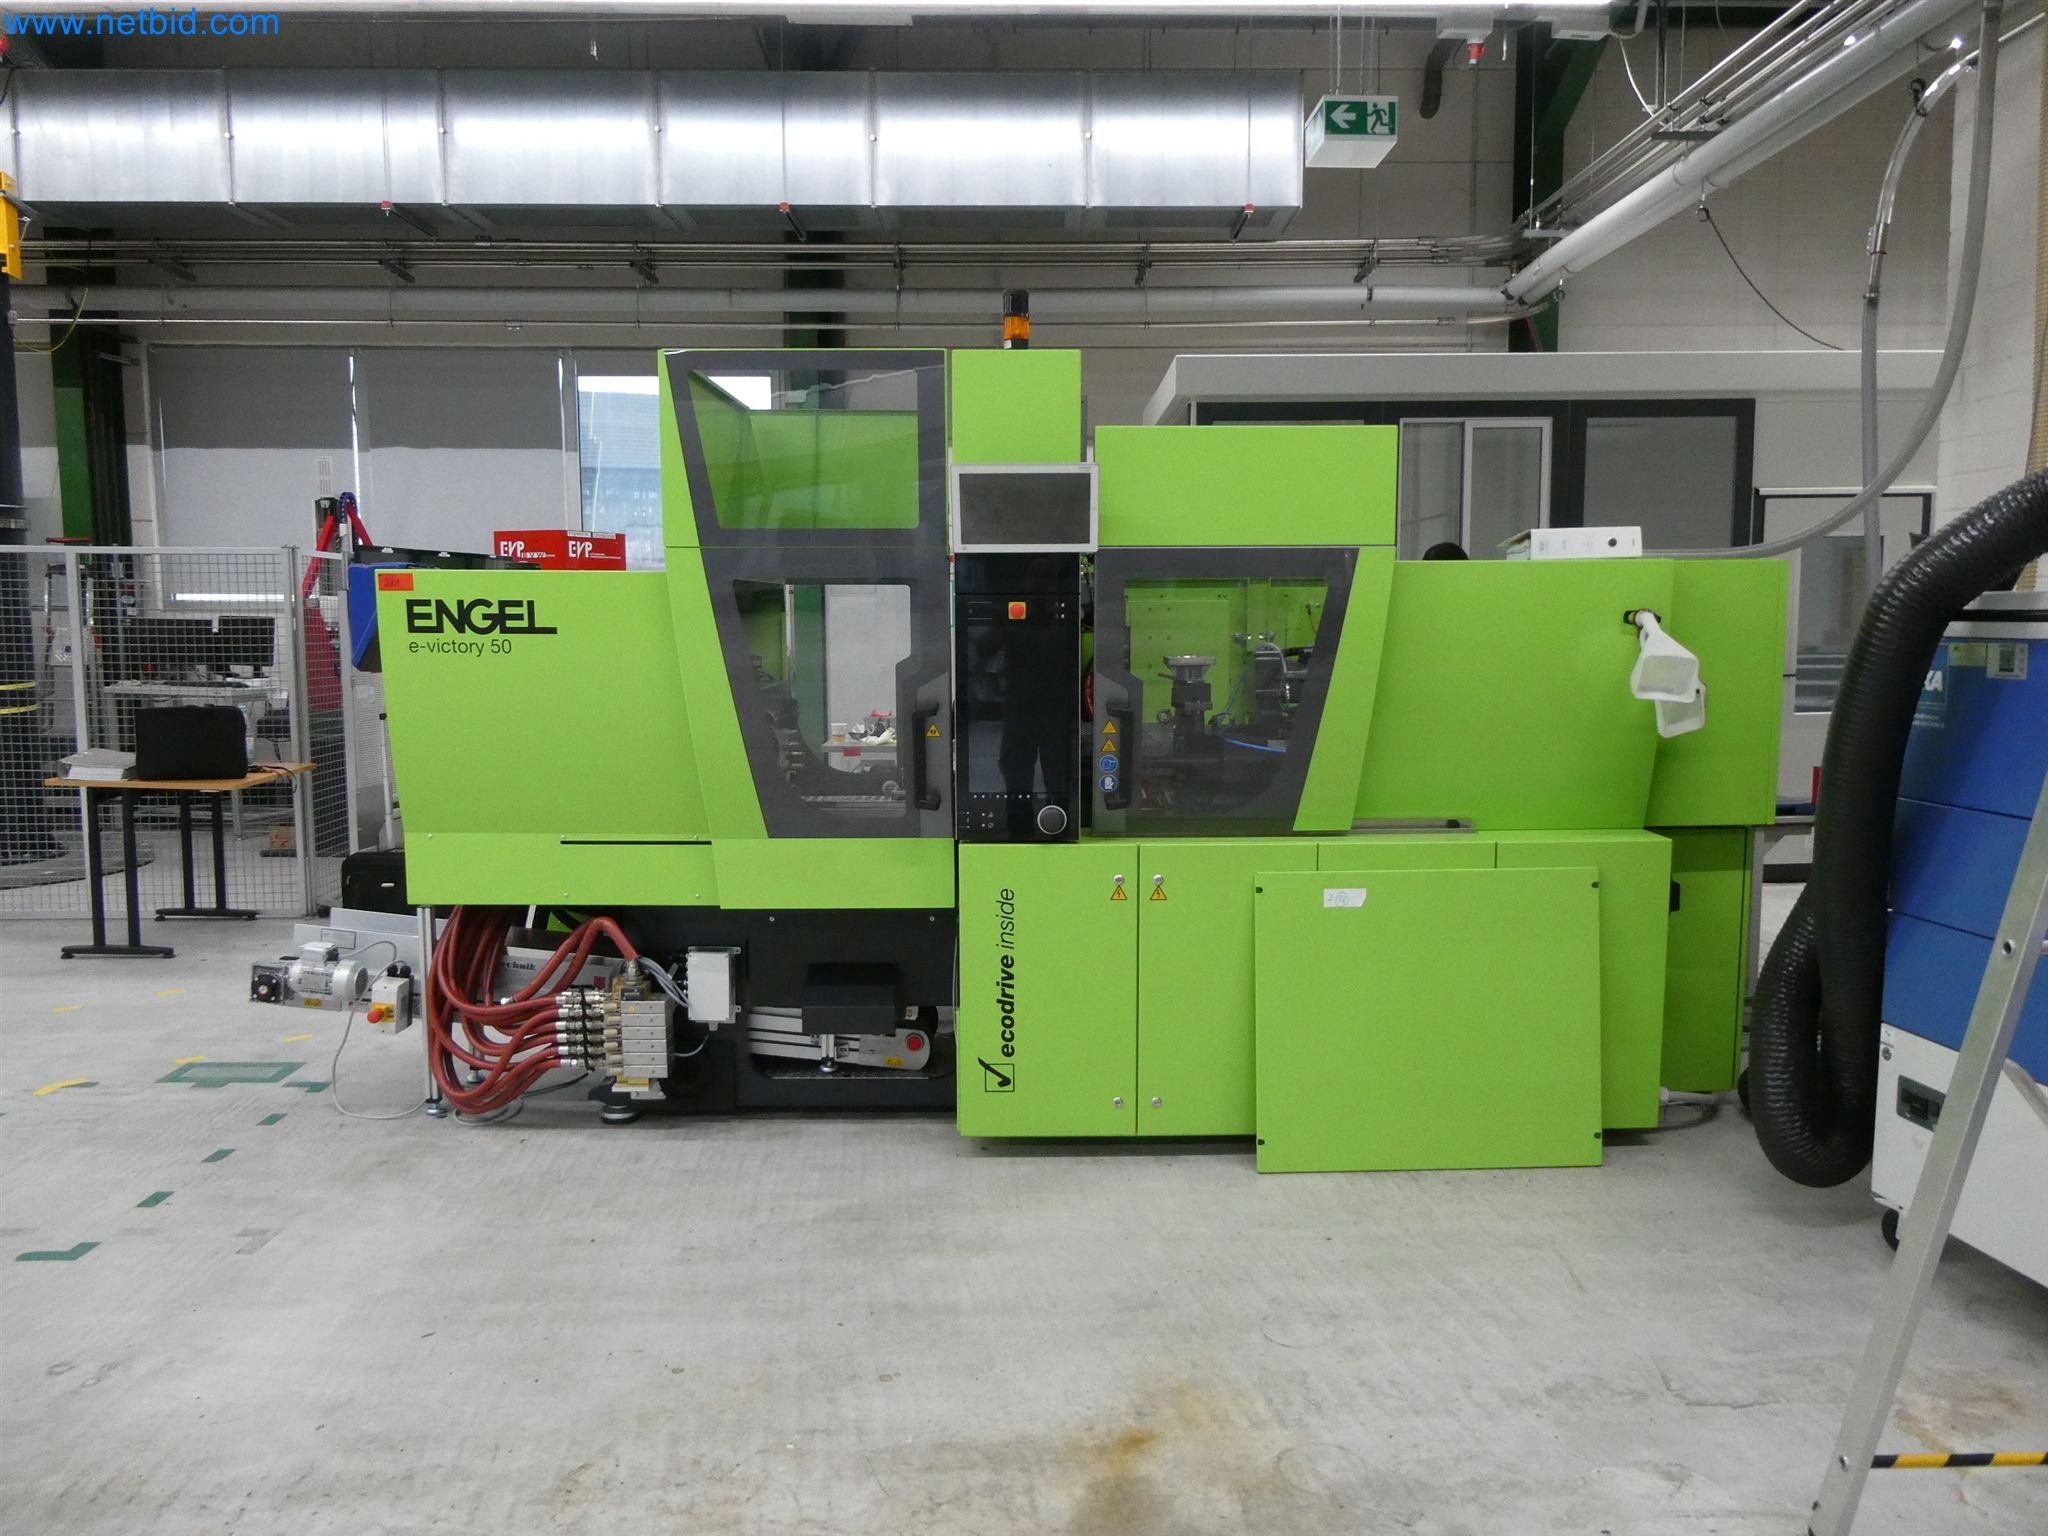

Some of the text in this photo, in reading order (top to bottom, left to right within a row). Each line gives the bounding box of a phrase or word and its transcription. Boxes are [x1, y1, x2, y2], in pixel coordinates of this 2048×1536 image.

[406, 599, 558, 635] ENGEL
[409, 638, 512, 657] e-victory 50
[995, 888, 1016, 1058] ecodrive inside
